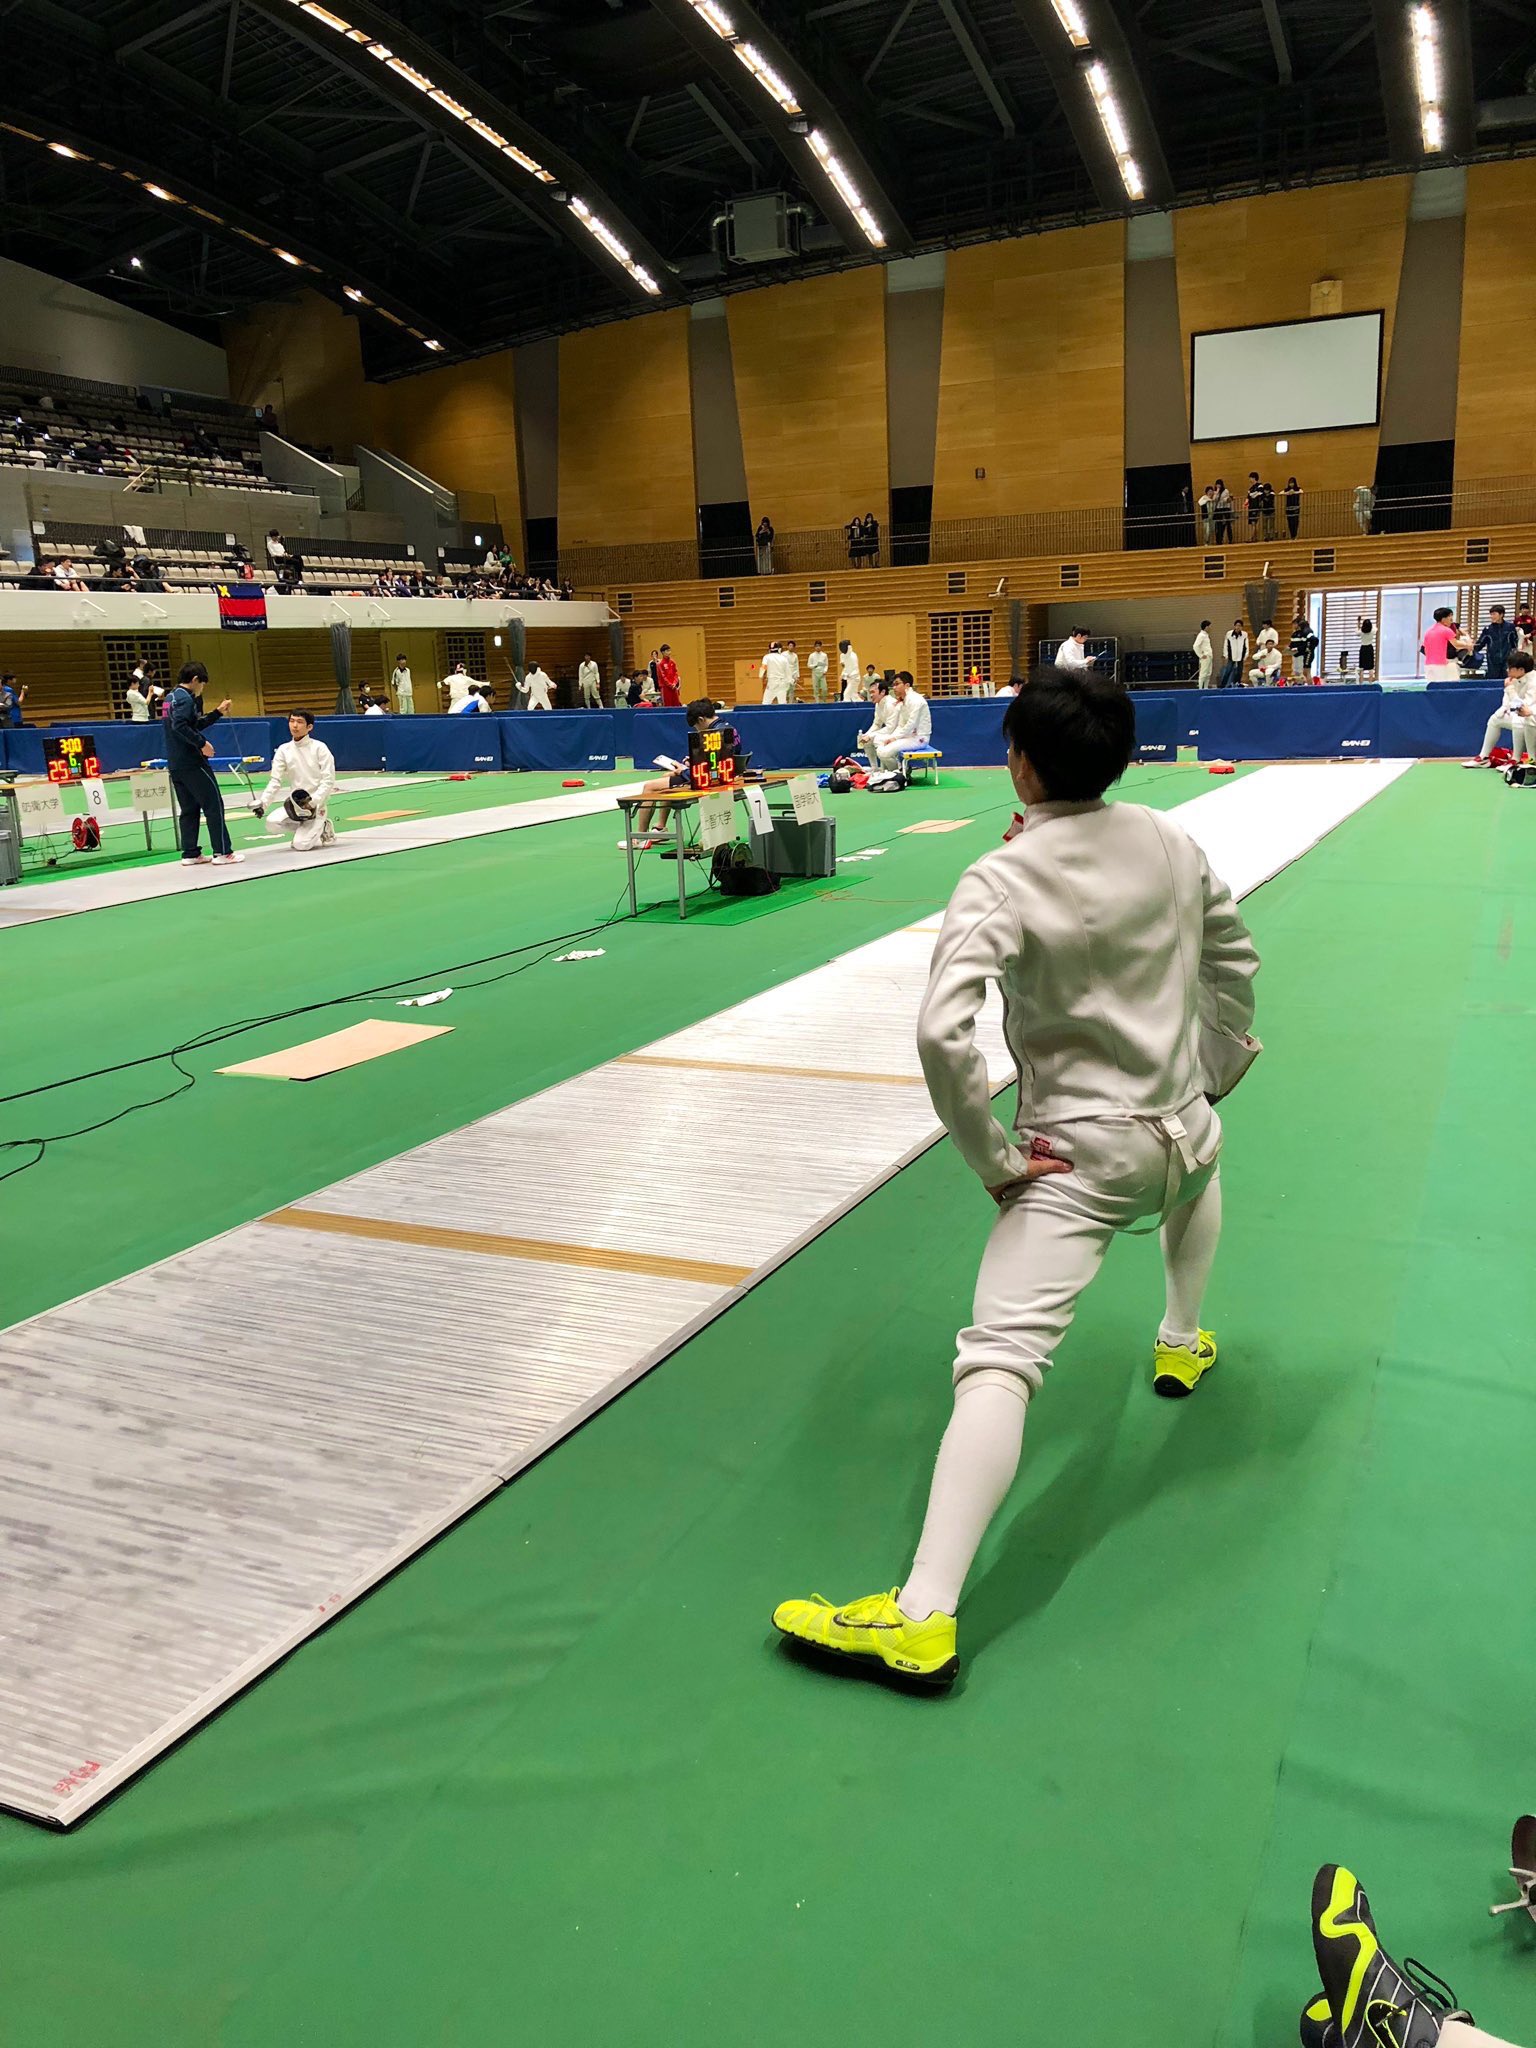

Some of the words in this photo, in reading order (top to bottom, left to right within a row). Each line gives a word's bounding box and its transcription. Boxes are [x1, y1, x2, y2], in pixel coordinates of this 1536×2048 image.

[60, 738, 82, 753] 3:00
[703, 732, 721, 751] 3:00
[49, 760, 69, 780] 25
[85, 757, 99, 776] 12
[69, 753, 77, 766] 6
[710, 752, 717, 769] 9
[692, 762, 709, 787] 45
[717, 758, 733, 782] 42
[93, 790, 101, 805] 8
[754, 799, 762, 819] 7
